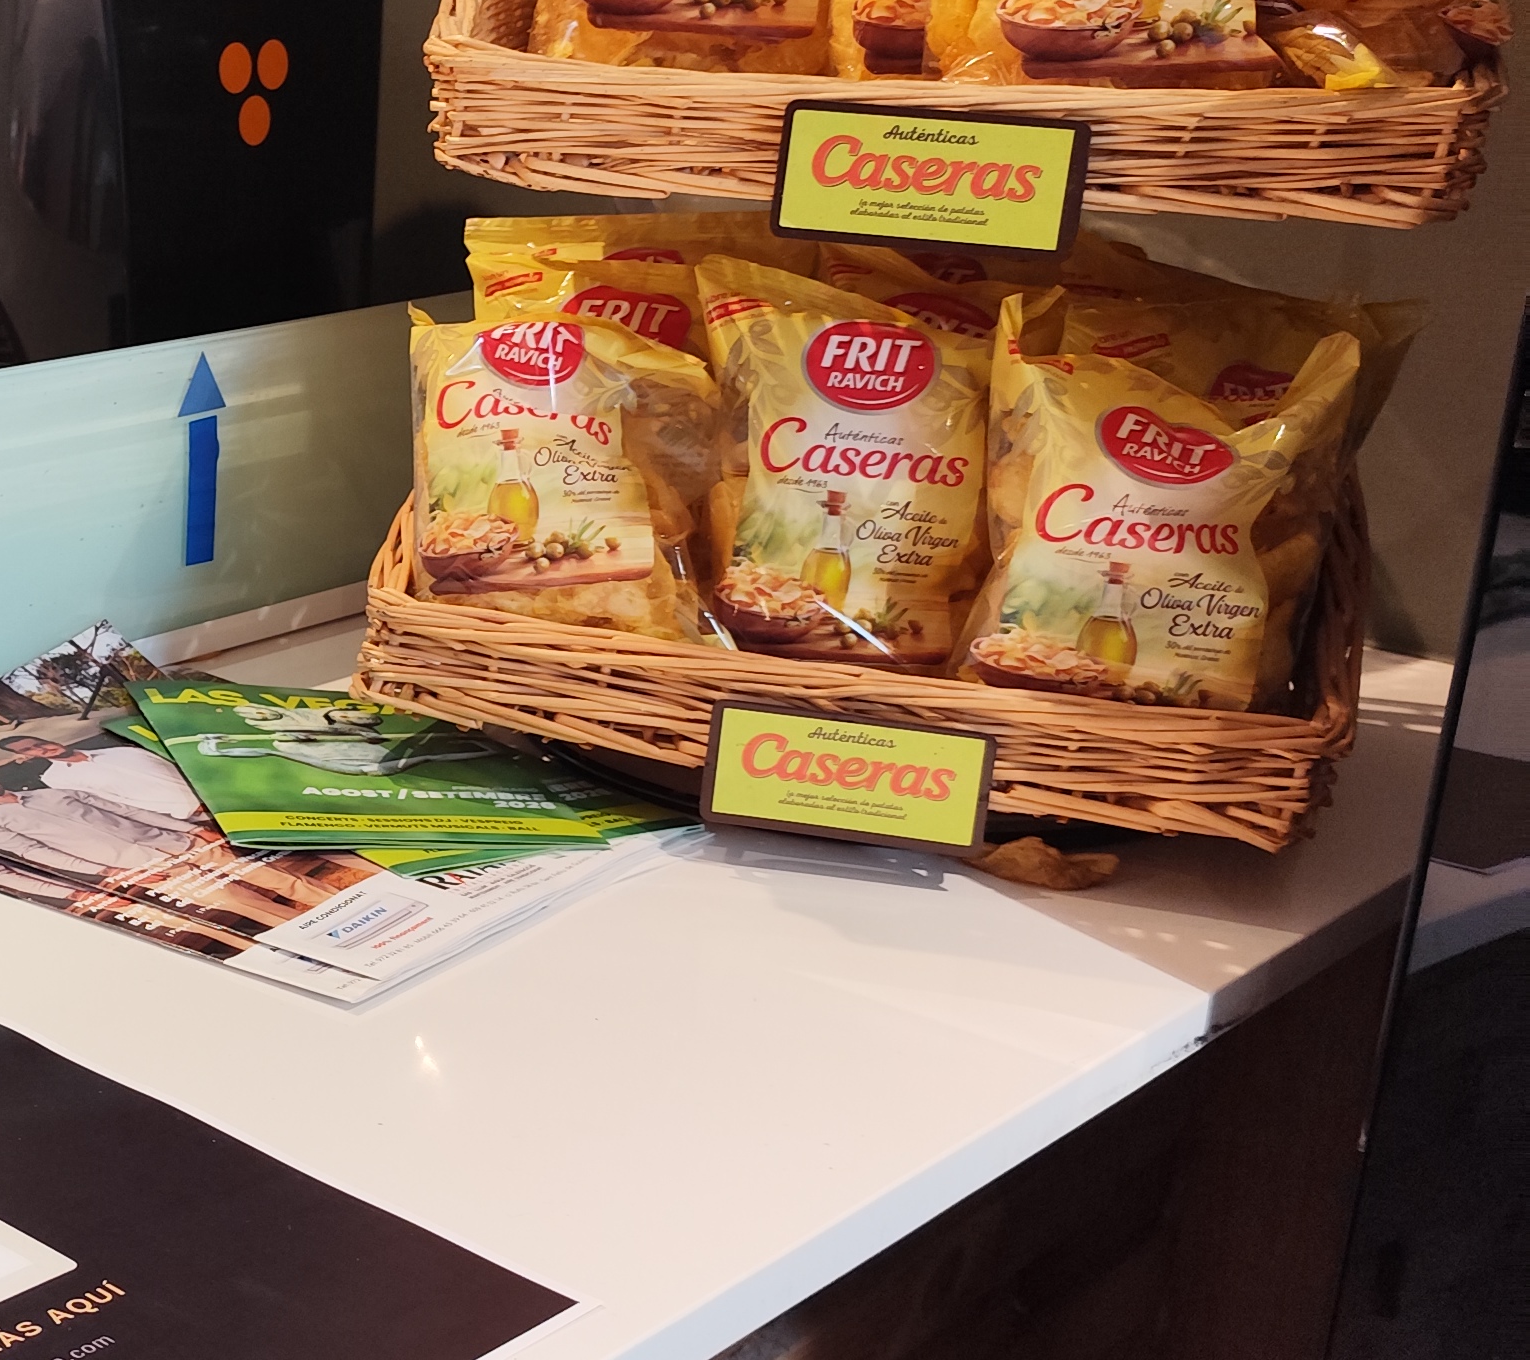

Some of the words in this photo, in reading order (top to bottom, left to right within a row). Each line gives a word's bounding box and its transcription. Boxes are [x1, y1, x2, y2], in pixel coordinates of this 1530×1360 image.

[883, 125, 979, 146] Auténticas
[811, 134, 1043, 203] Caseras
[491, 322, 579, 353] FRIT
[495, 343, 563, 371] RAVICH
[820, 334, 925, 373] FRIT
[827, 372, 905, 392] RAVICH
[824, 422, 904, 446] Auténticas
[1116, 413, 1216, 465] FRIT
[760, 416, 970, 488] Caseras
[1122, 443, 1200, 474] RAVICH
[563, 465, 618, 485] Extra
[881, 501, 938, 524] Aceite
[1035, 483, 1239, 554] Caseras
[856, 519, 903, 543] Oliva
[904, 525, 959, 549] Virgen
[876, 544, 934, 566] Extra
[1168, 573, 1232, 593] Aceite
[1140, 587, 1193, 611] Oliva
[1196, 594, 1260, 619] Virgen
[1168, 613, 1234, 639] Extra
[144, 687, 251, 707] LAS
[807, 726, 897, 749] Auténticas
[741, 732, 957, 802] Caseras
[411, 790, 548, 802] SETEMBRE
[279, 821, 356, 829] FLAMENCO
[284, 815, 358, 823] CONCERTS
[316, 891, 367, 921] CONDICIONAT
[341, 906, 388, 934] DAIKIN
[45, 1278, 127, 1325] AQUÍ
